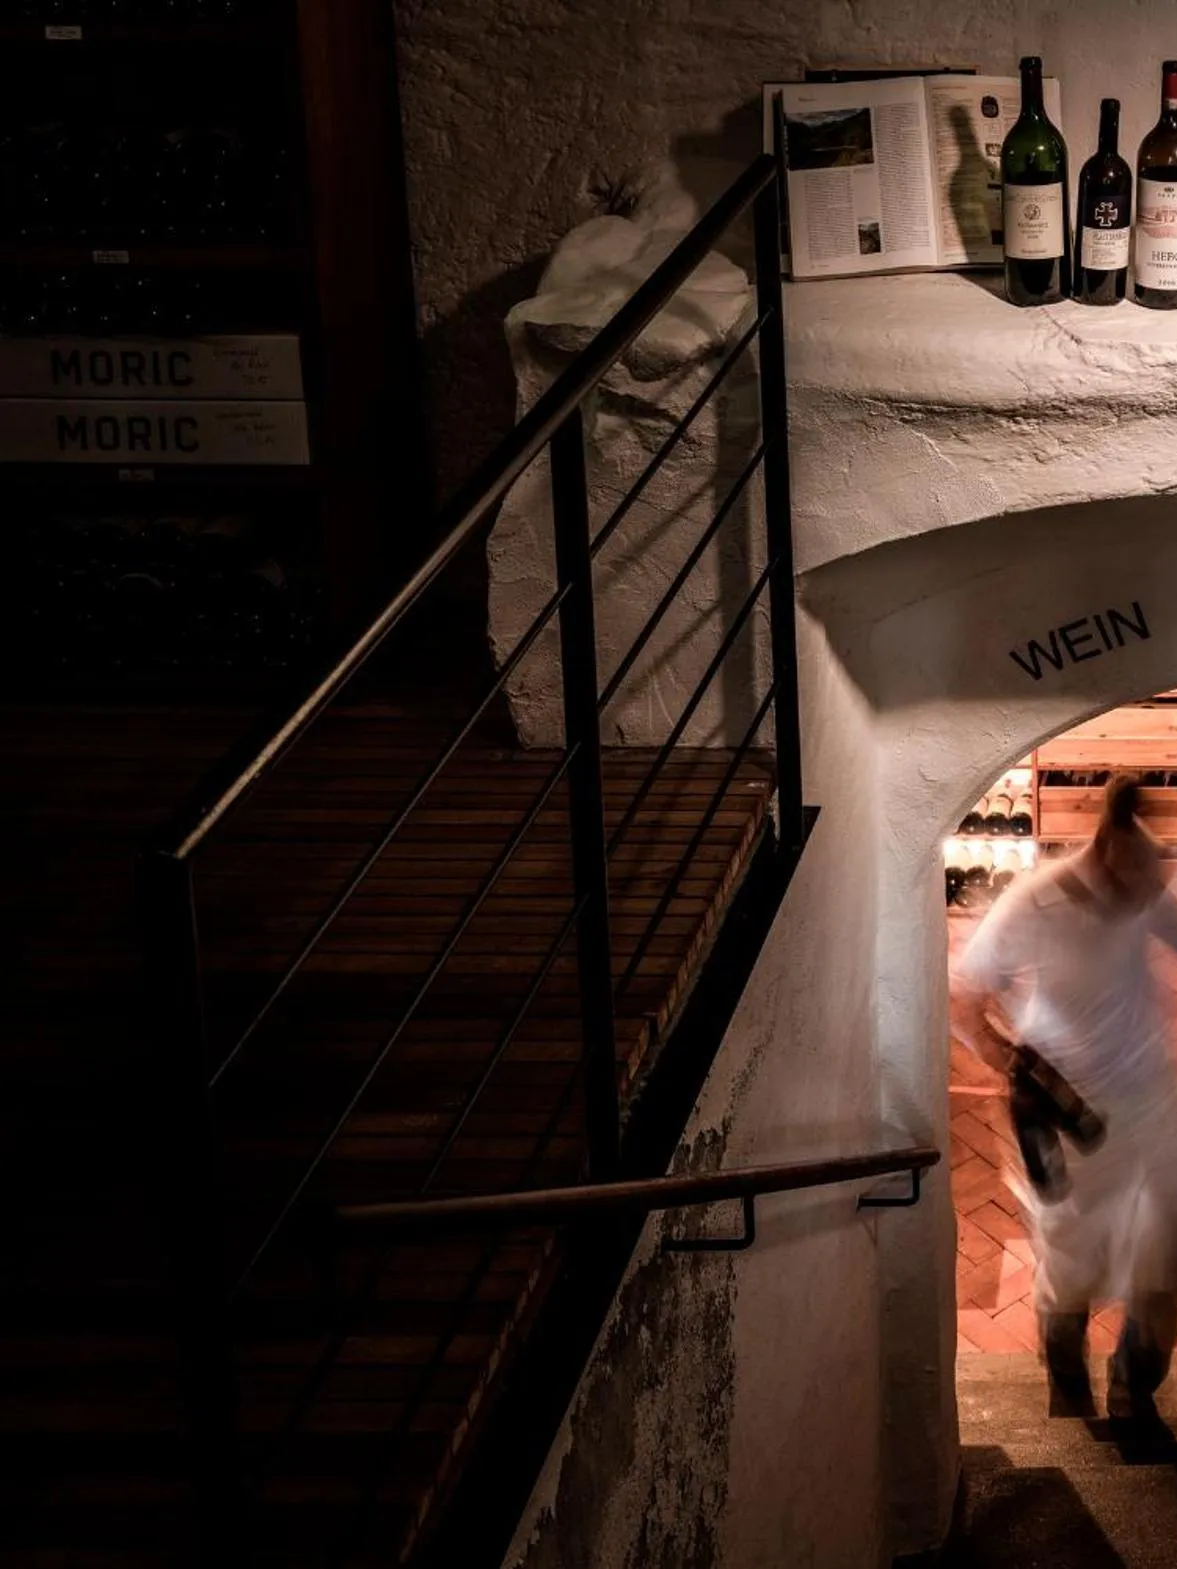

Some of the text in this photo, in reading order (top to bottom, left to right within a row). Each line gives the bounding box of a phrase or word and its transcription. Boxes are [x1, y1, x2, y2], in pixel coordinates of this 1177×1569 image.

[51, 349, 193, 386] MORIC
[56, 415, 199, 452] MORIC
[1009, 602, 1150, 681] WEIN
